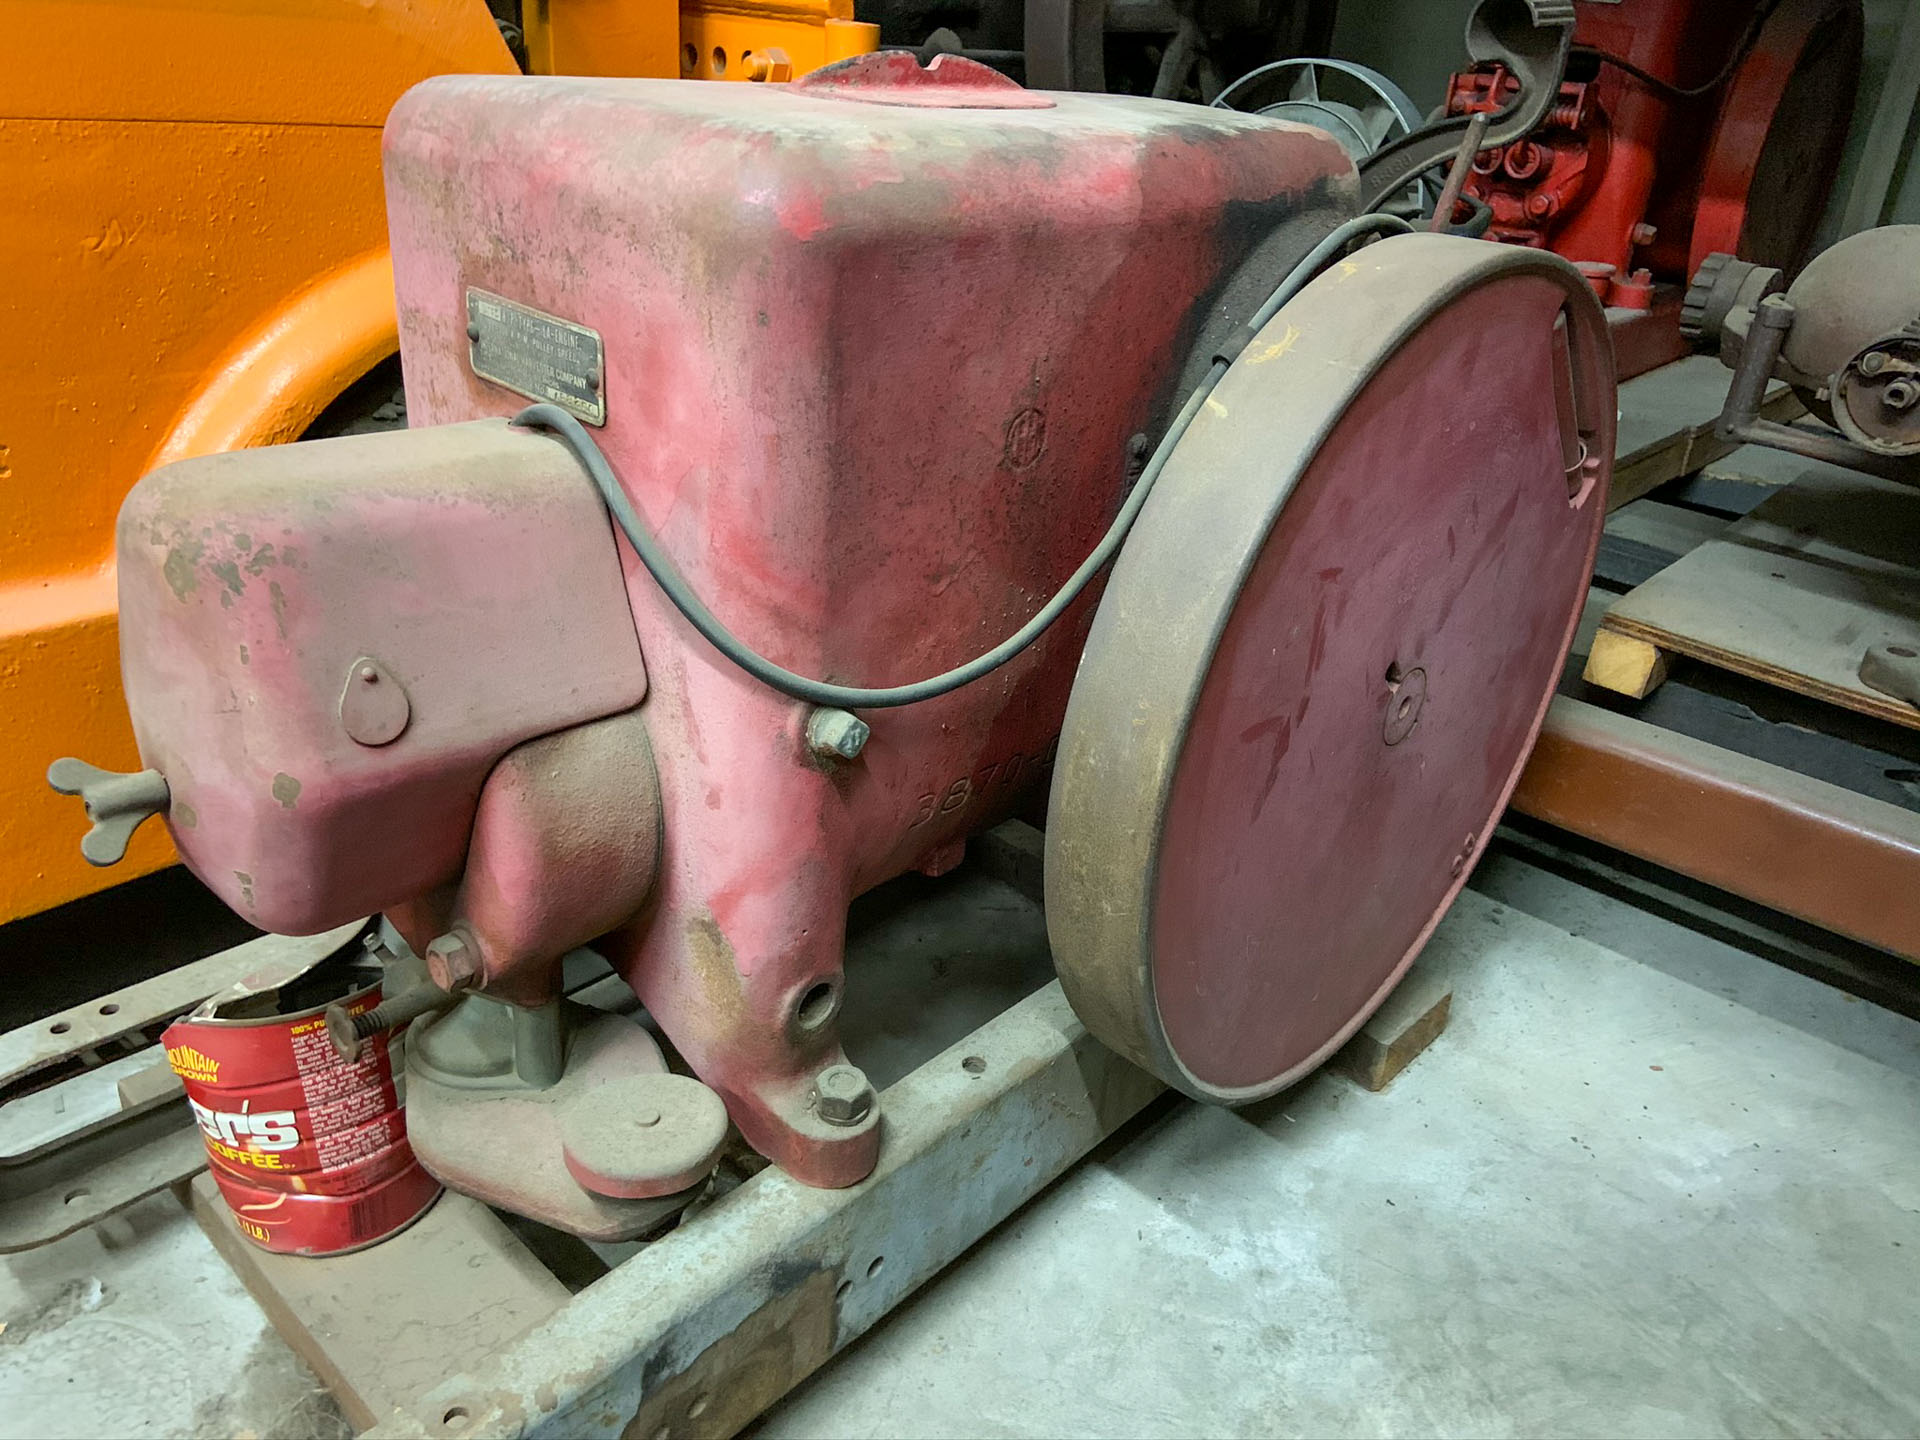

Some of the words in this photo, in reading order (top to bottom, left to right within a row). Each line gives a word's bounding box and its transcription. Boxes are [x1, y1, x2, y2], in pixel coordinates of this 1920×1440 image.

[555, 368, 587, 390] COMPANY
[291, 1023, 312, 1034] 100%
[205, 1135, 283, 1169] COFFEE
